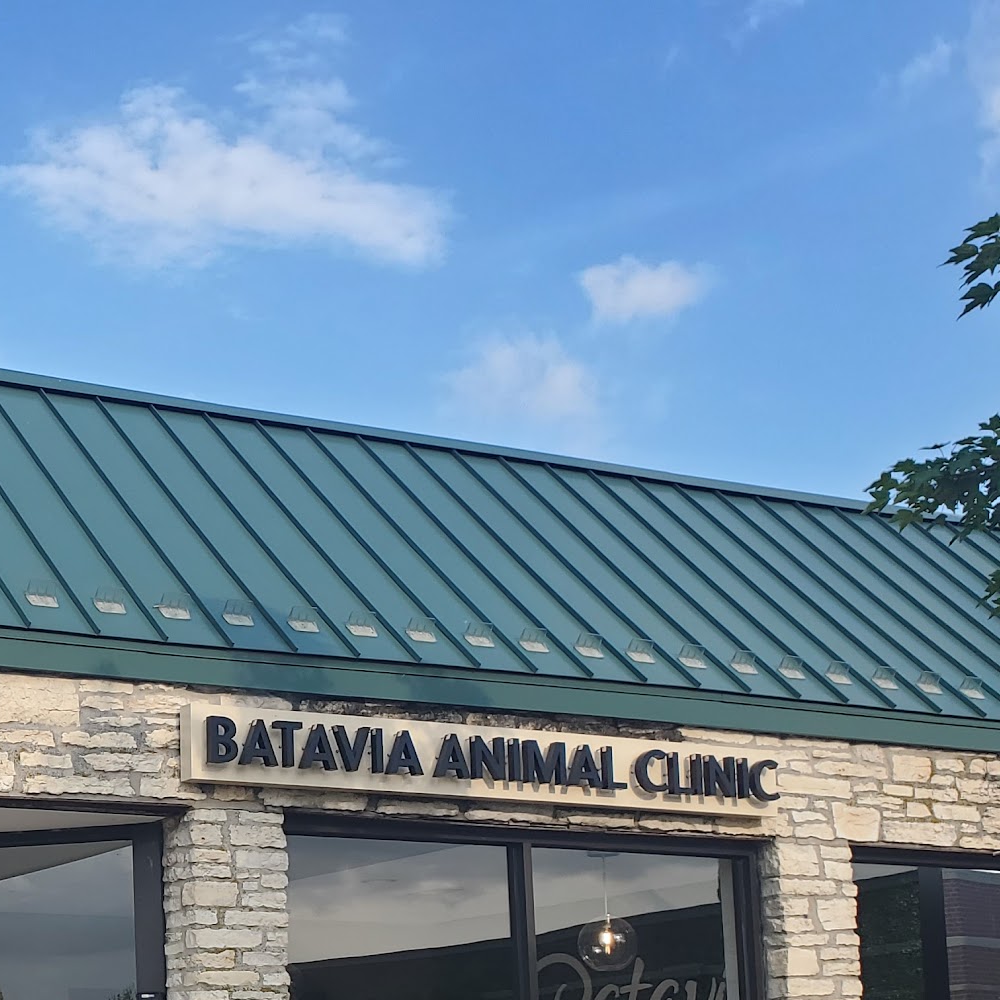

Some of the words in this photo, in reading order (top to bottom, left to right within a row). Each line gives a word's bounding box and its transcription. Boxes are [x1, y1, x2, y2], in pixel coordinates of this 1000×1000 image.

[206, 716, 424, 776] BATAVIA
[433, 733, 627, 790] ANIMAL
[634, 749, 780, 800] CLINIC
